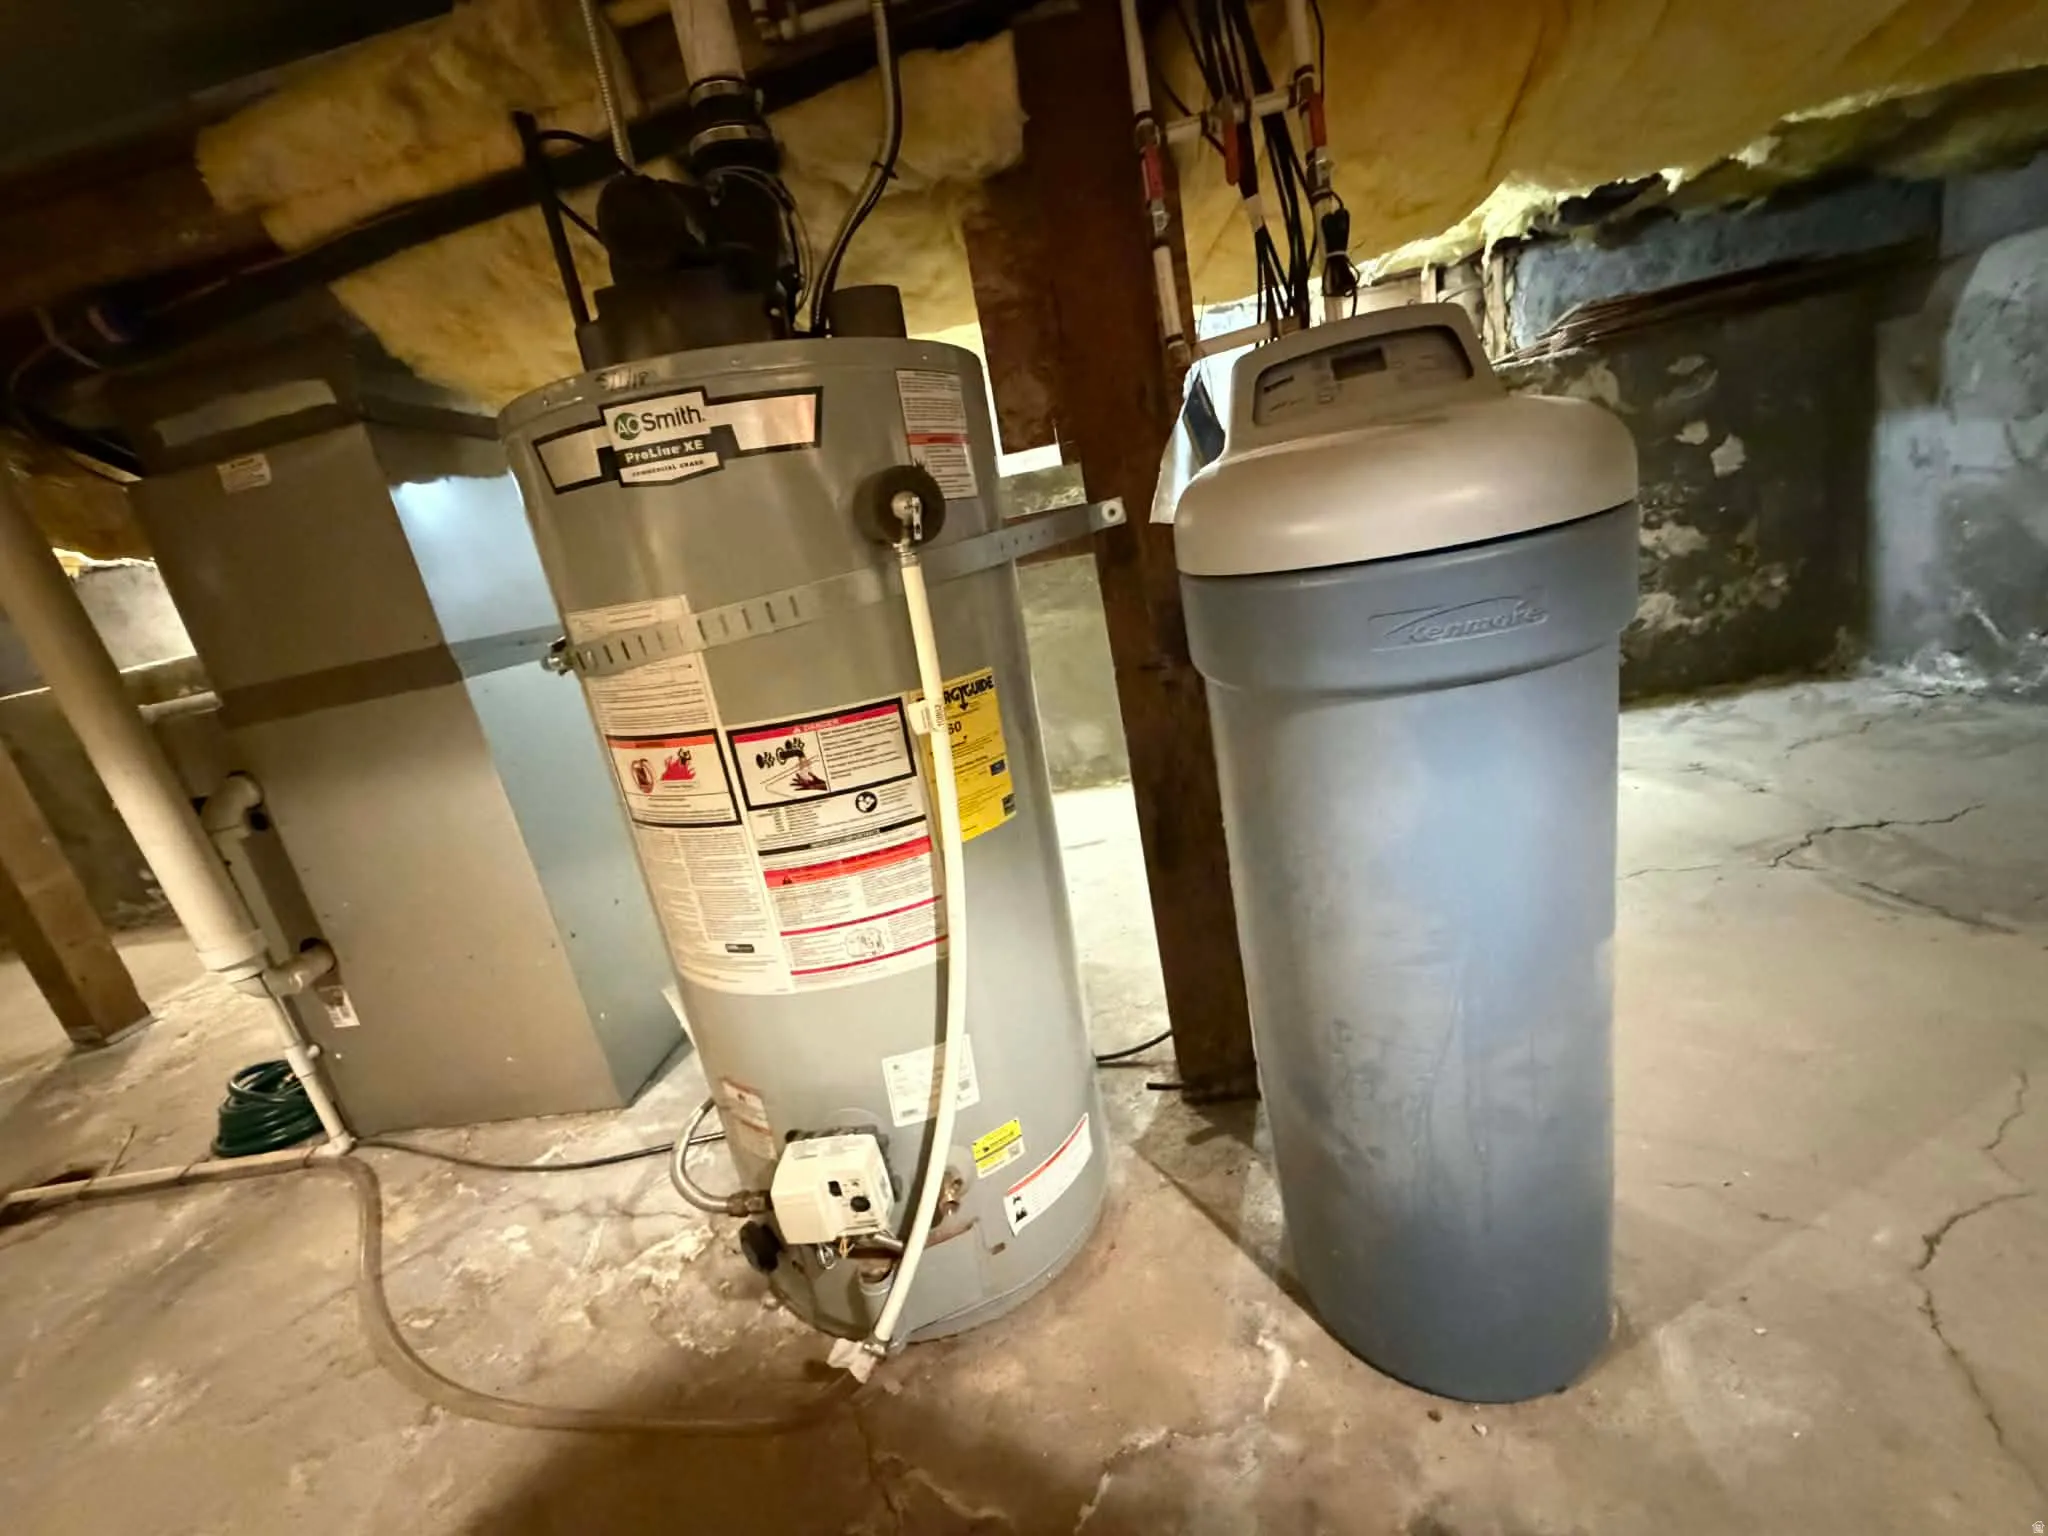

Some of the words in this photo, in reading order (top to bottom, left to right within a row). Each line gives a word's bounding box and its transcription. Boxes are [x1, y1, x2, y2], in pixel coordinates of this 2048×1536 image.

[640, 405, 702, 432] Smith
[624, 443, 681, 464] ProLine
[683, 439, 705, 453] XE
